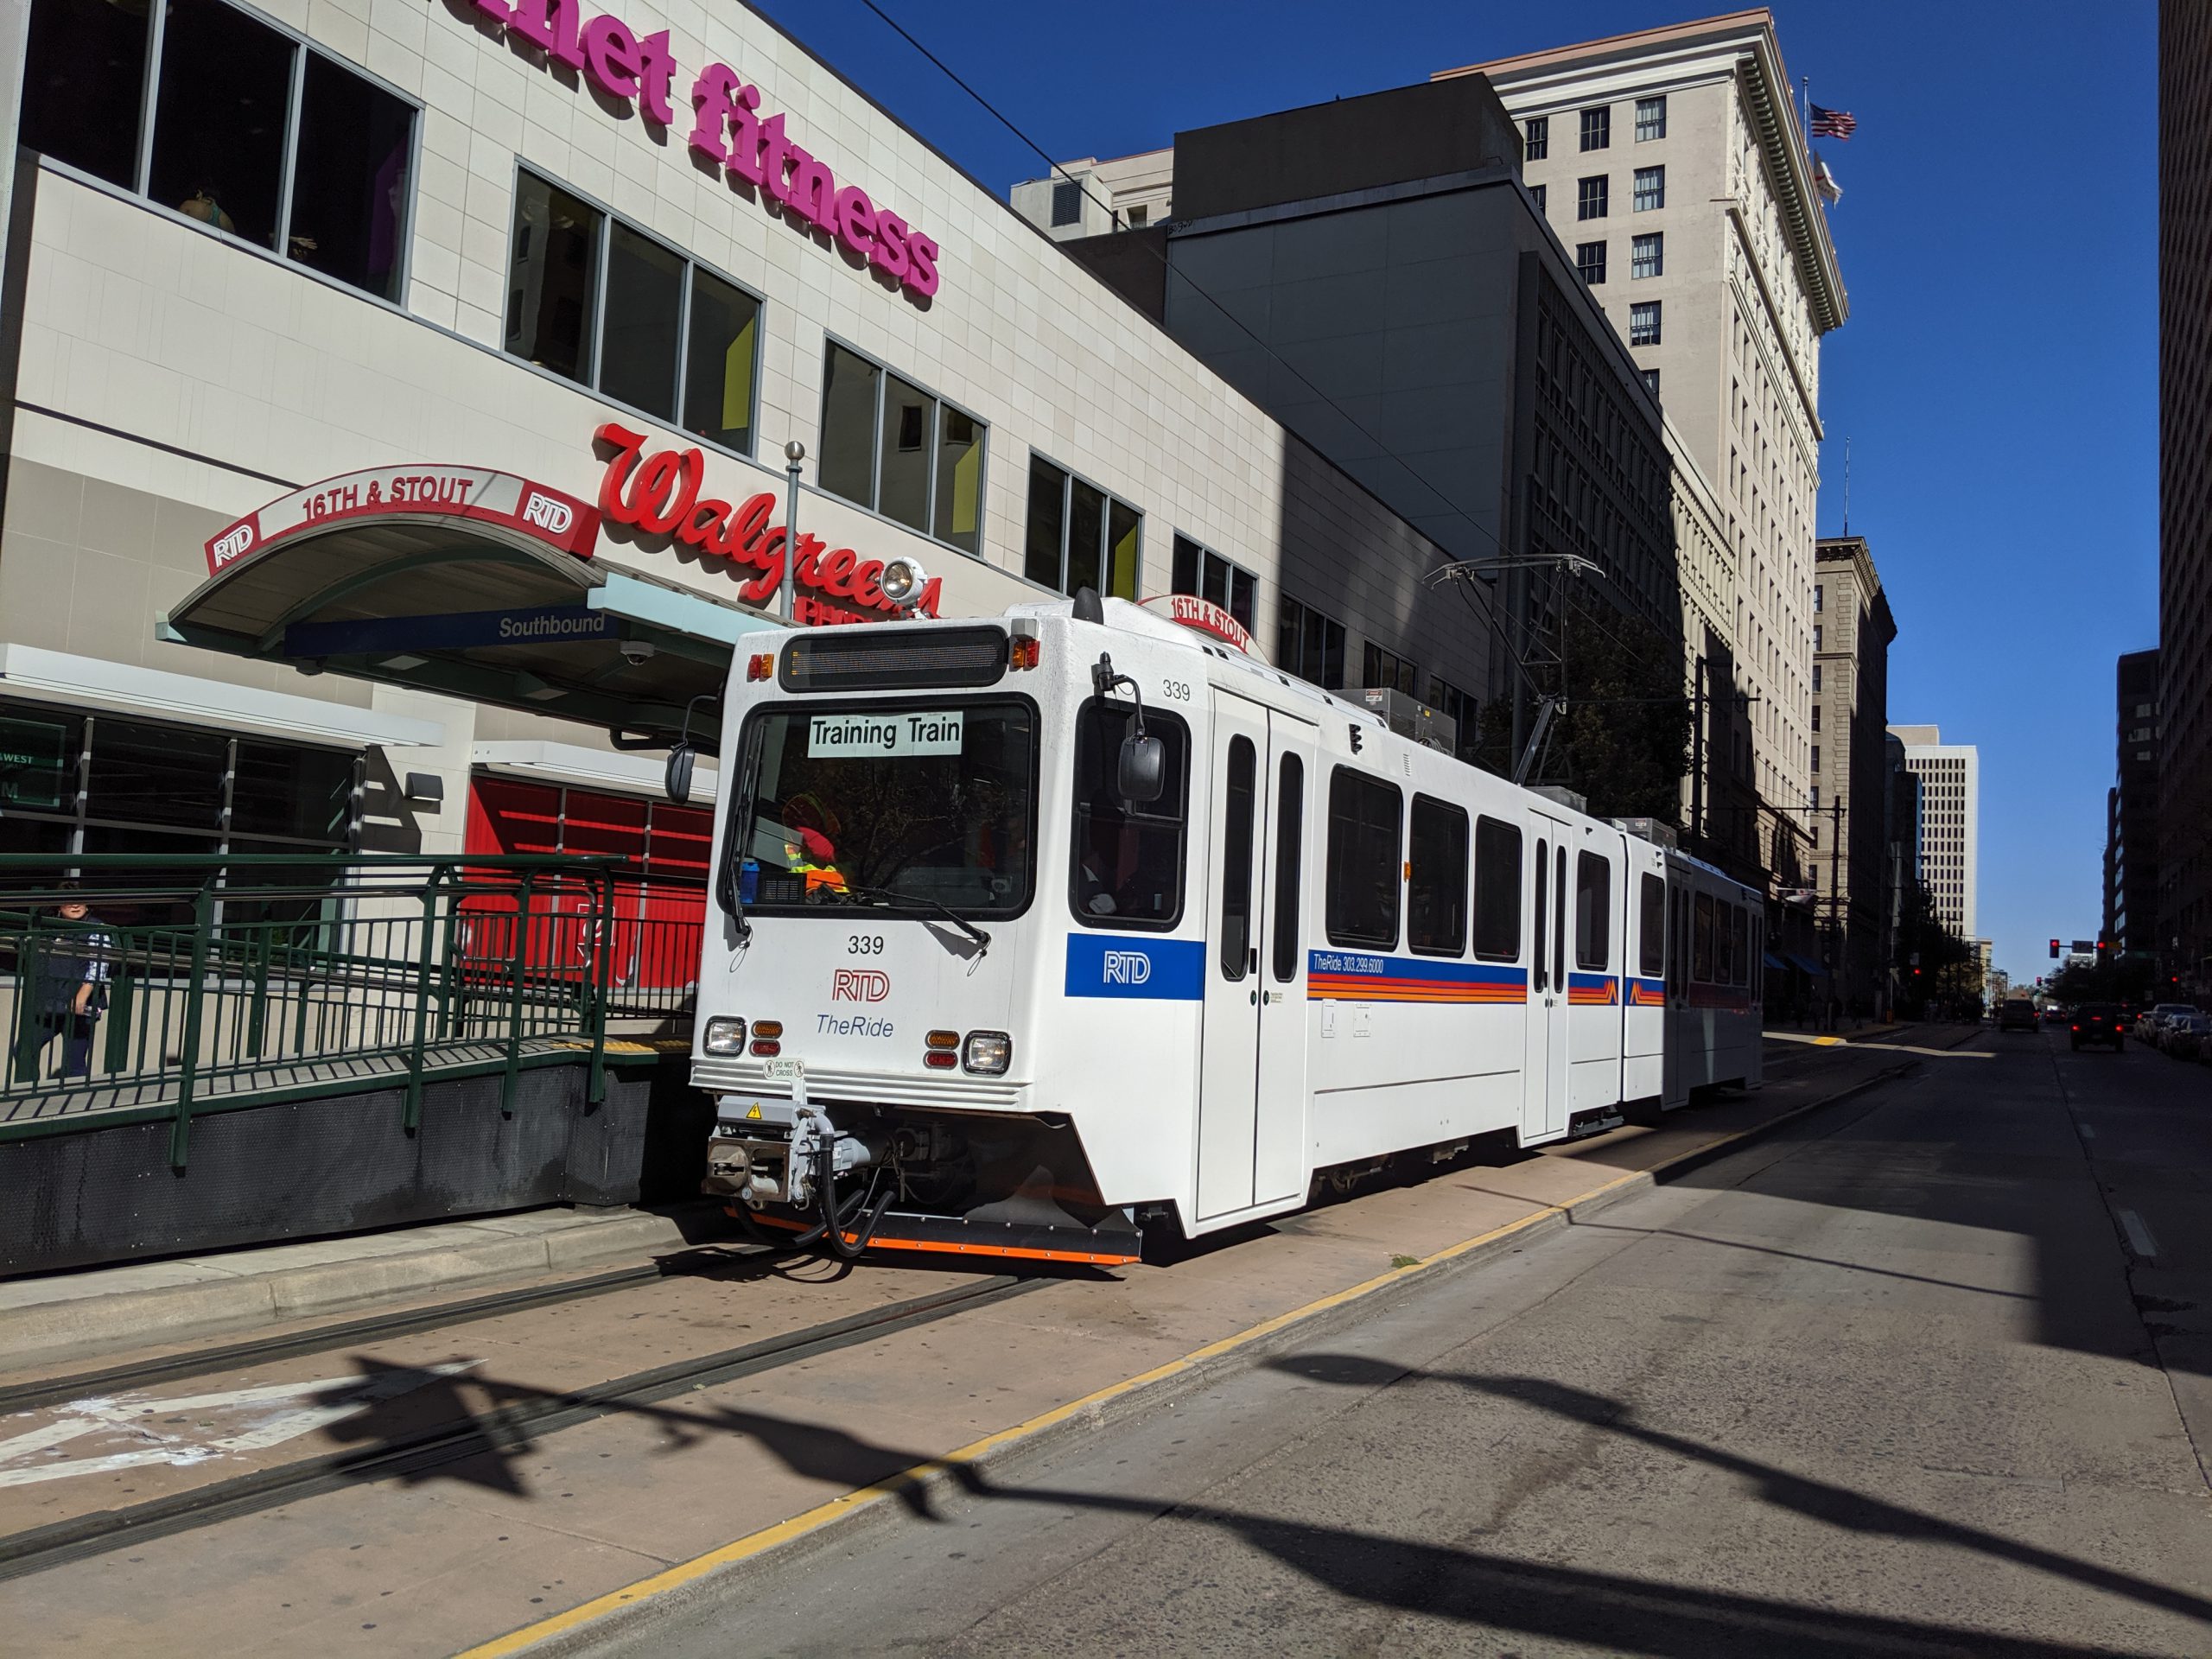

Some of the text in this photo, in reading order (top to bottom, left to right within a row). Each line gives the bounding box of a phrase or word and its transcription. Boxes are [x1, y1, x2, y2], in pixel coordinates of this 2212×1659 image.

[469, 0, 938, 297] net fitness
[302, 475, 474, 521] 16TH & STOUT
[522, 493, 573, 534] RTD
[213, 524, 254, 568] RTD
[499, 612, 605, 640] Southbound
[1171, 597, 1249, 651] 16TH & STOUT
[1162, 679, 1191, 702] 339
[812, 715, 960, 750] Training Train
[848, 935, 884, 955] 339
[1103, 950, 1151, 984] RTD
[1313, 953, 1384, 974] TheRide 303.299.6000
[831, 969, 890, 1002] RTD
[817, 1014, 894, 1038] TheRide
